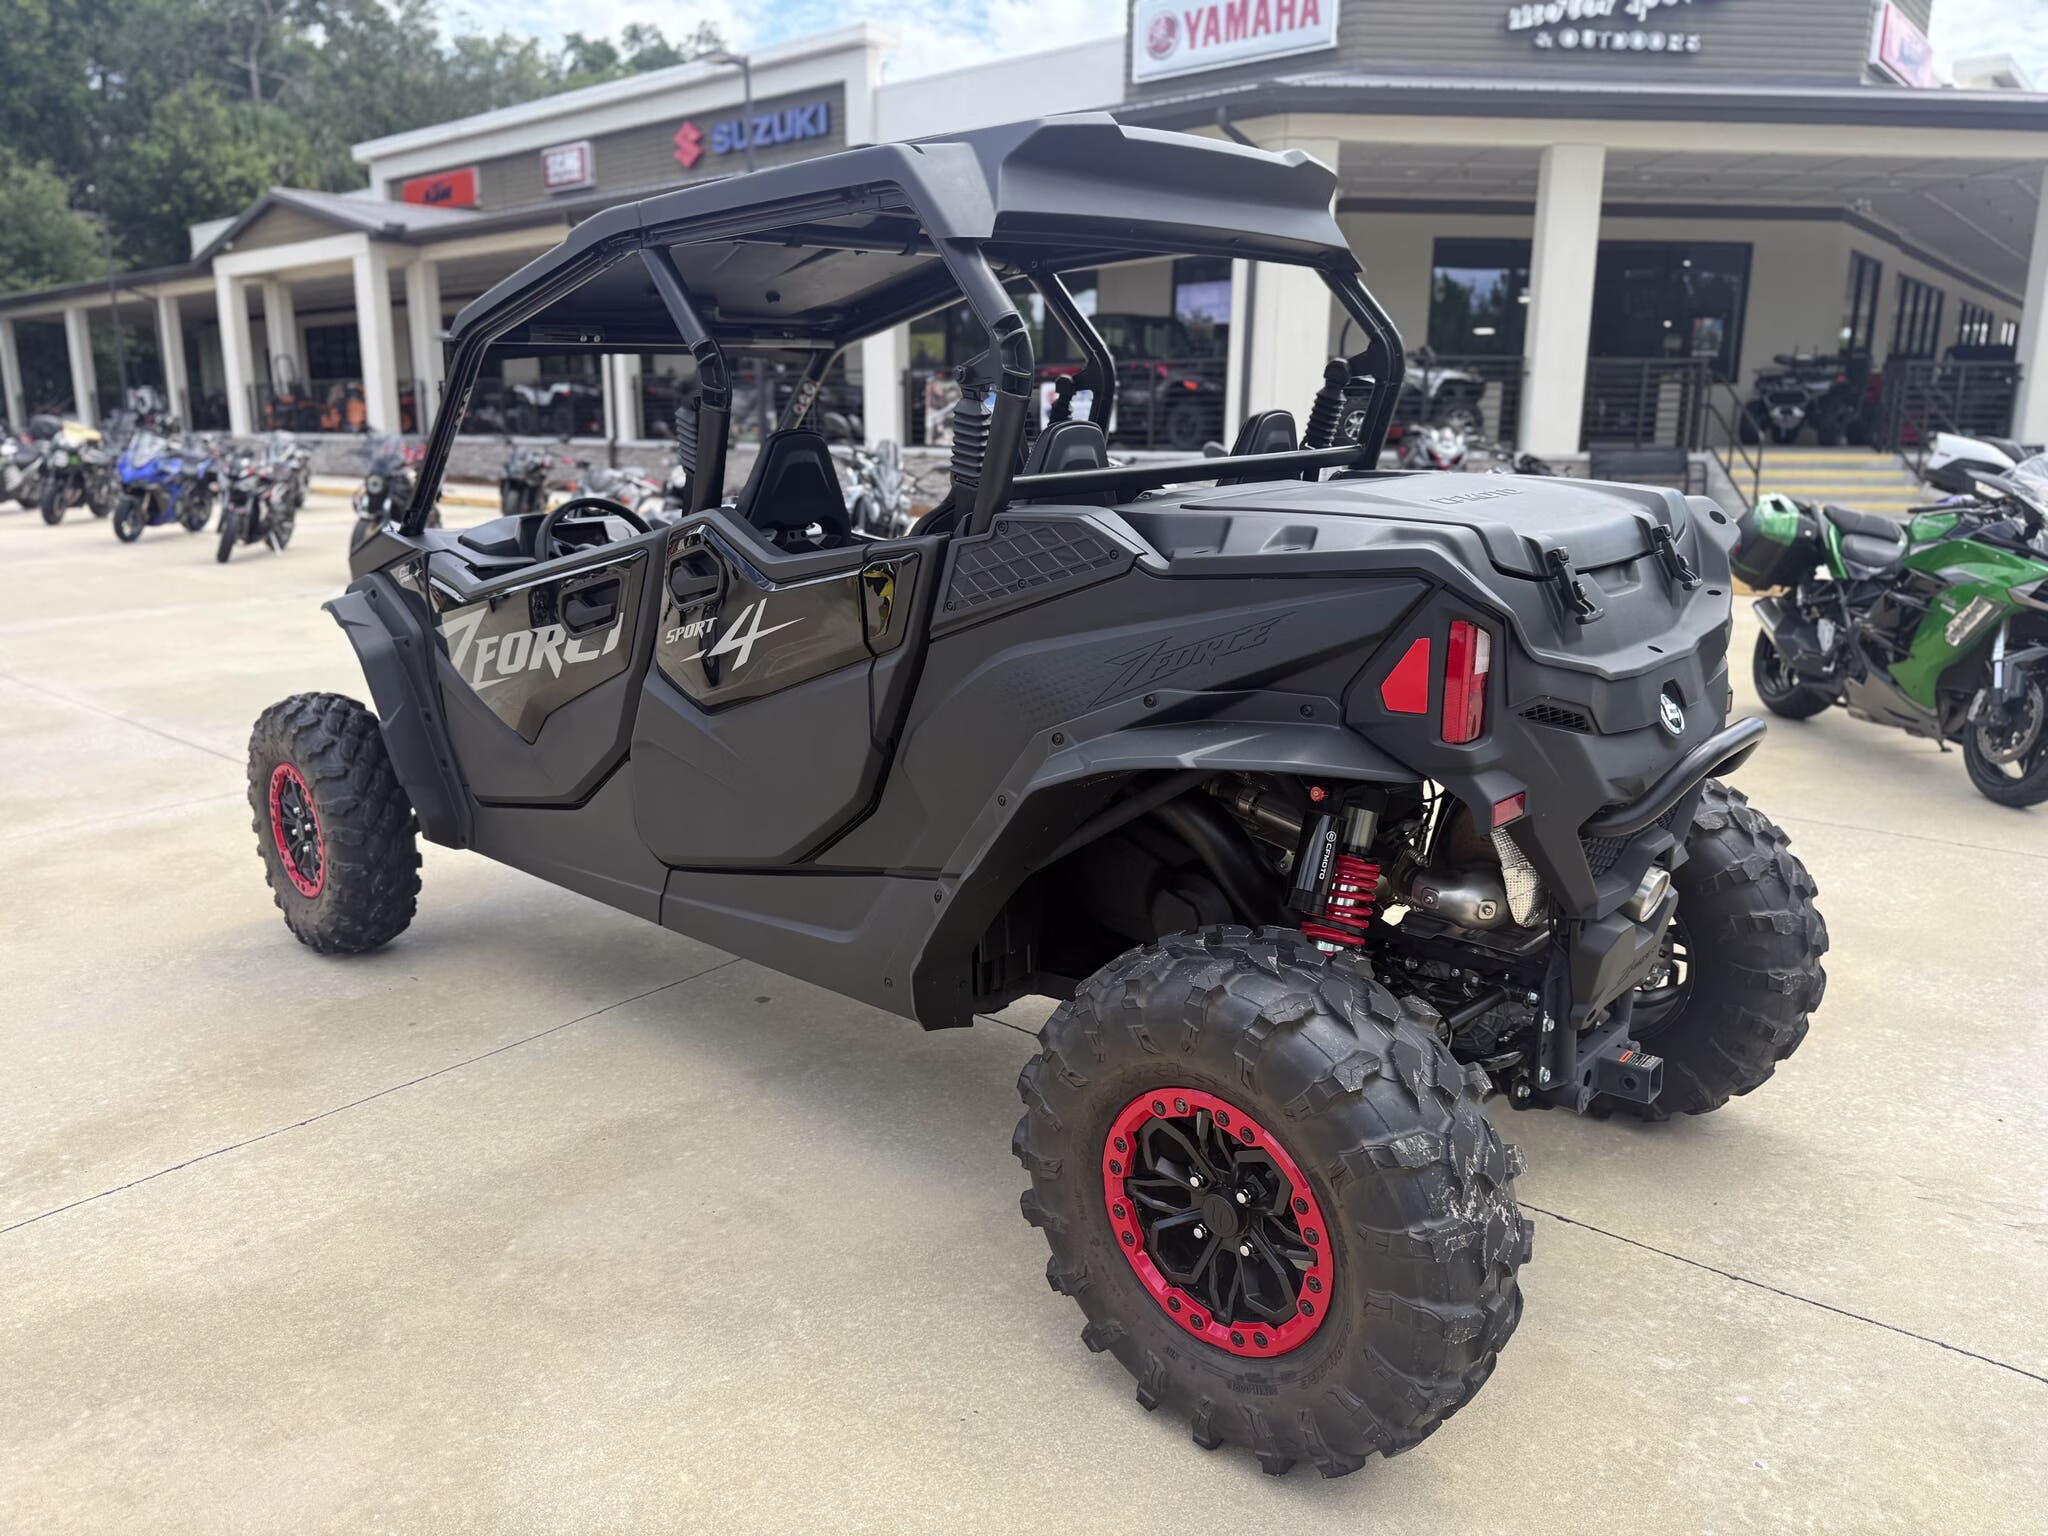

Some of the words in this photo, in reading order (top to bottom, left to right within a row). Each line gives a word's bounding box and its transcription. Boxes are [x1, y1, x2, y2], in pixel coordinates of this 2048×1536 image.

[1184, 0, 1321, 50] YAMAHA
[1558, 27, 1701, 52] OUTDOORS
[710, 101, 830, 155] SUZUKI
[664, 616, 718, 646] SPORT
[680, 597, 807, 673] 4
[1318, 842, 1333, 881] CFMOTO
